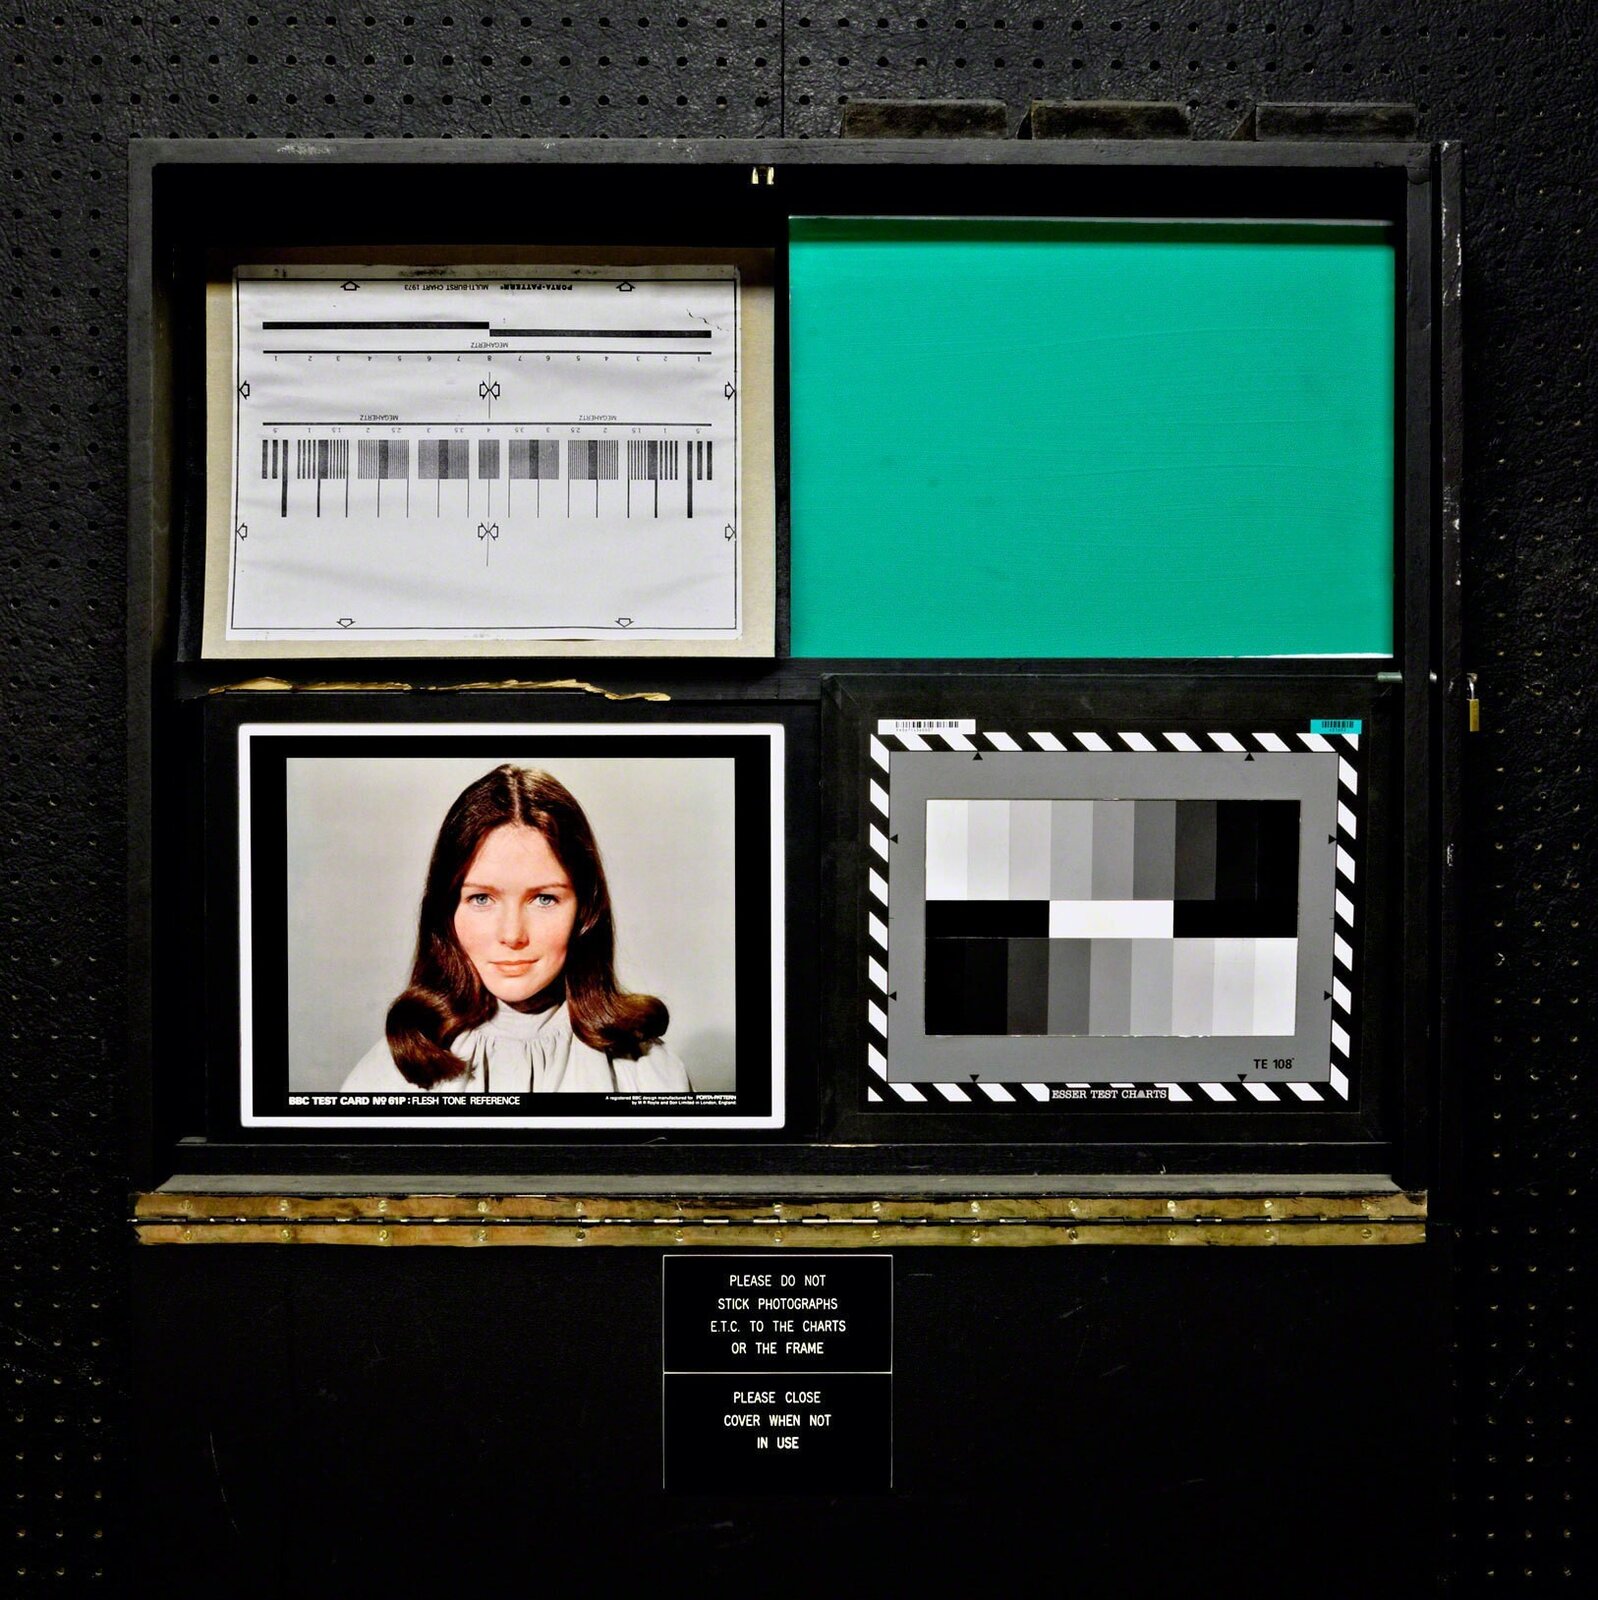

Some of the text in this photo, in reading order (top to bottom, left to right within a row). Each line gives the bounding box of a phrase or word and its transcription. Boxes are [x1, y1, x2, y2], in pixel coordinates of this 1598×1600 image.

[1254, 1058, 1268, 1070] TE
[1052, 1090, 1167, 1098] ESSER TEST CHARTS
[288, 1096, 310, 1106] BBC
[312, 1096, 338, 1106] TEST
[340, 1096, 370, 1106] CARD
[442, 1096, 466, 1106] TONE
[470, 1096, 520, 1106] REFERENCE
[730, 1274, 826, 1286] PLEASE DO NOT
[718, 1298, 838, 1310] STICK PHOTOGRAPHS
[710, 1320, 846, 1332] E.T.C. TO THE CHARTS
[732, 1342, 824, 1354] OR THE FRAME
[734, 1392, 822, 1404] PLEASE CLOSE
[724, 1414, 832, 1426] COVER WHEN NOT
[757, 1437, 800, 1449] IN USE
